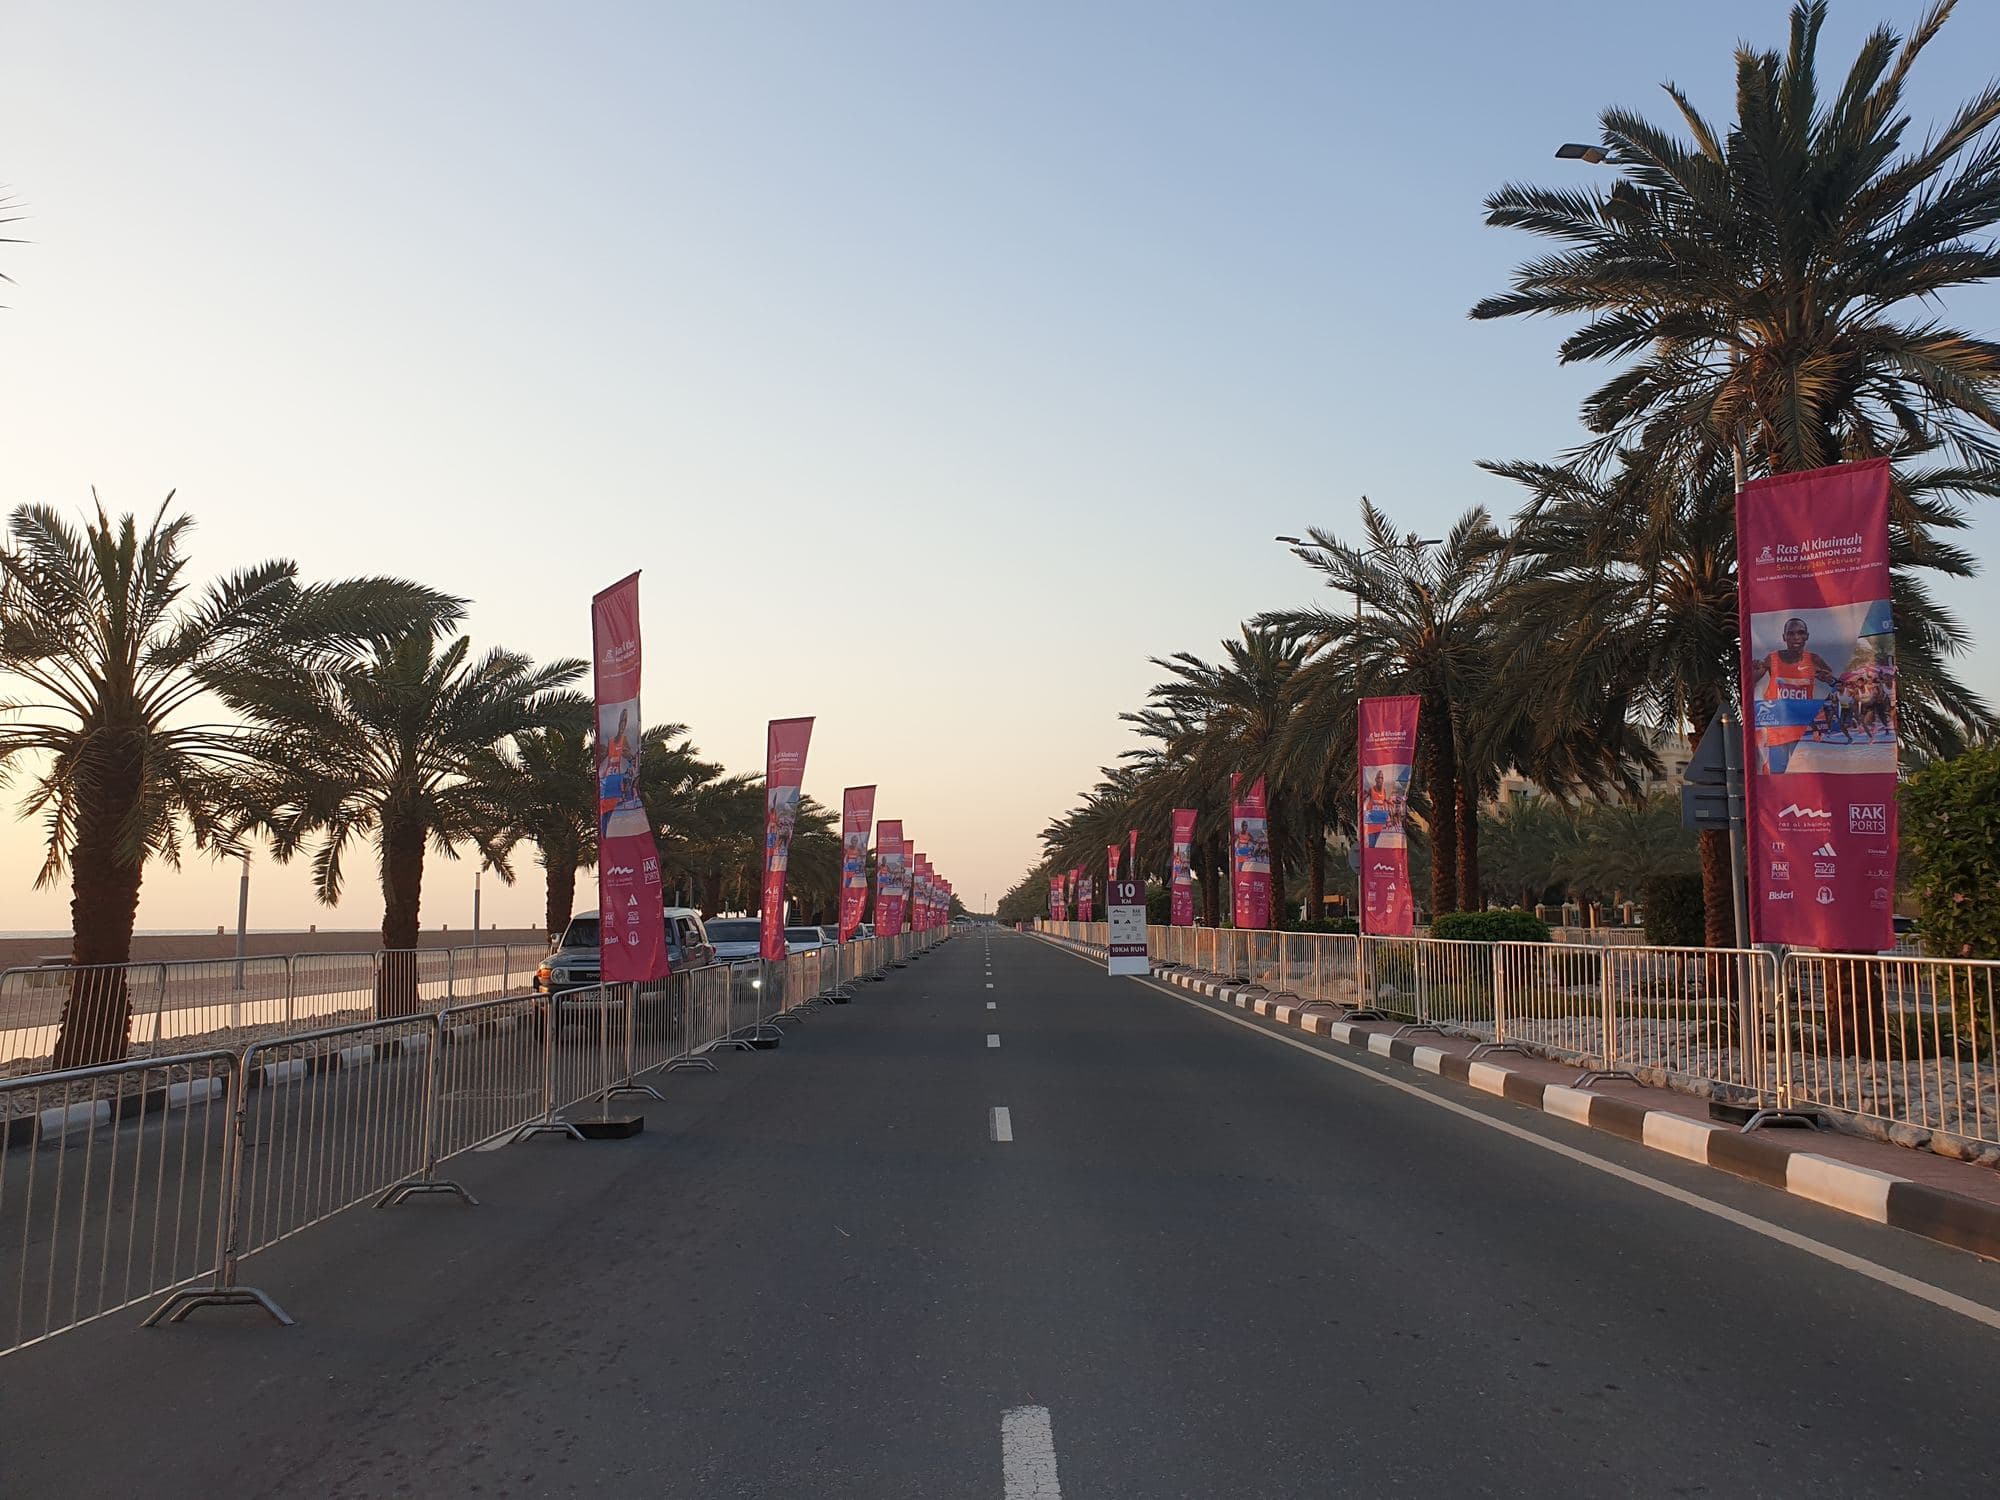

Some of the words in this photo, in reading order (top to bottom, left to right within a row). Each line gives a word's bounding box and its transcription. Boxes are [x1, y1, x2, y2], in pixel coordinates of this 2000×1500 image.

[1776, 544, 1799, 554] Ras
[1800, 540, 1810, 553] Al
[1811, 533, 1862, 551] Khaimah
[1800, 549, 1841, 561] MARATHON
[1842, 546, 1862, 555] 2024
[1776, 562, 1809, 571] Saturday
[1827, 557, 1861, 567] February
[1776, 687, 1808, 700] KOECH
[1850, 806, 1883, 820] RAK
[1851, 820, 1885, 831] PORTS
[1117, 883, 1136, 898] 10
[1130, 945, 1145, 953] RUN
